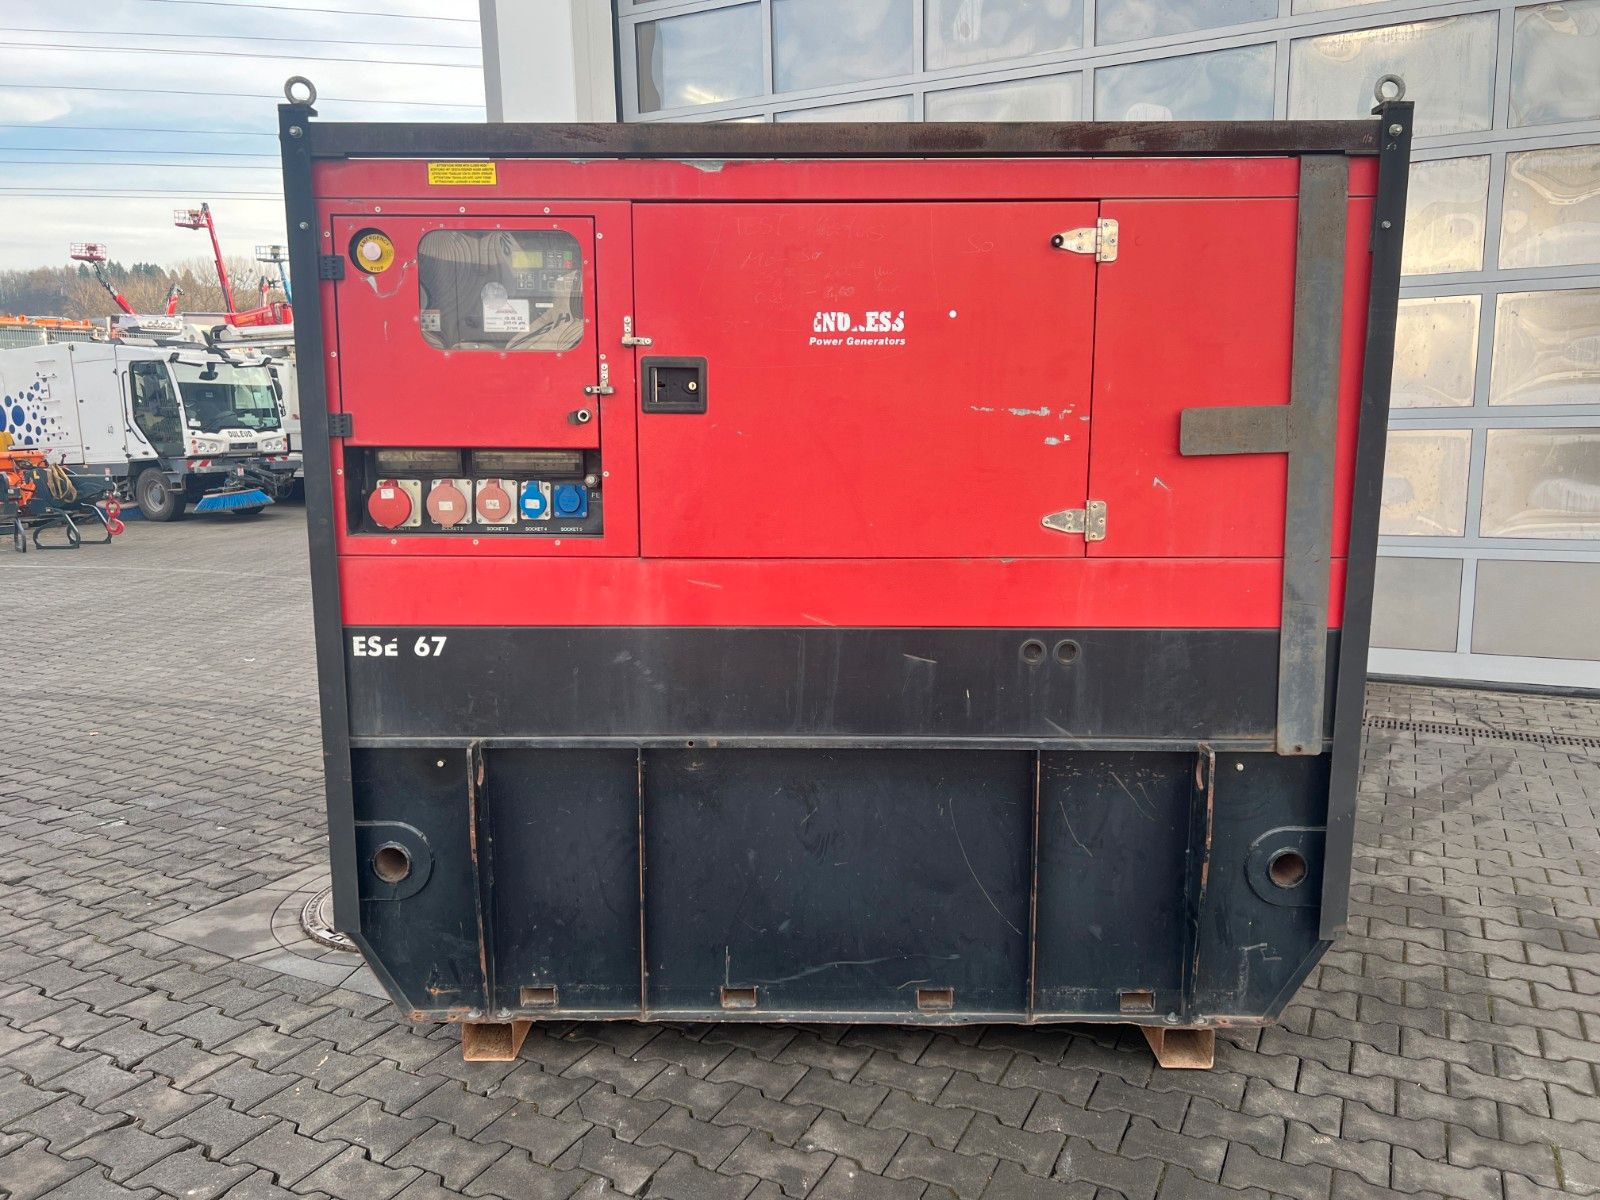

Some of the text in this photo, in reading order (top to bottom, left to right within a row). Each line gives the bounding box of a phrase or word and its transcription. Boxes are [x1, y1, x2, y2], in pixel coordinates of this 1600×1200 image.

[813, 311, 905, 333] ENDESS
[808, 336, 906, 346] Power Generators
[352, 635, 447, 657] ESE 67
